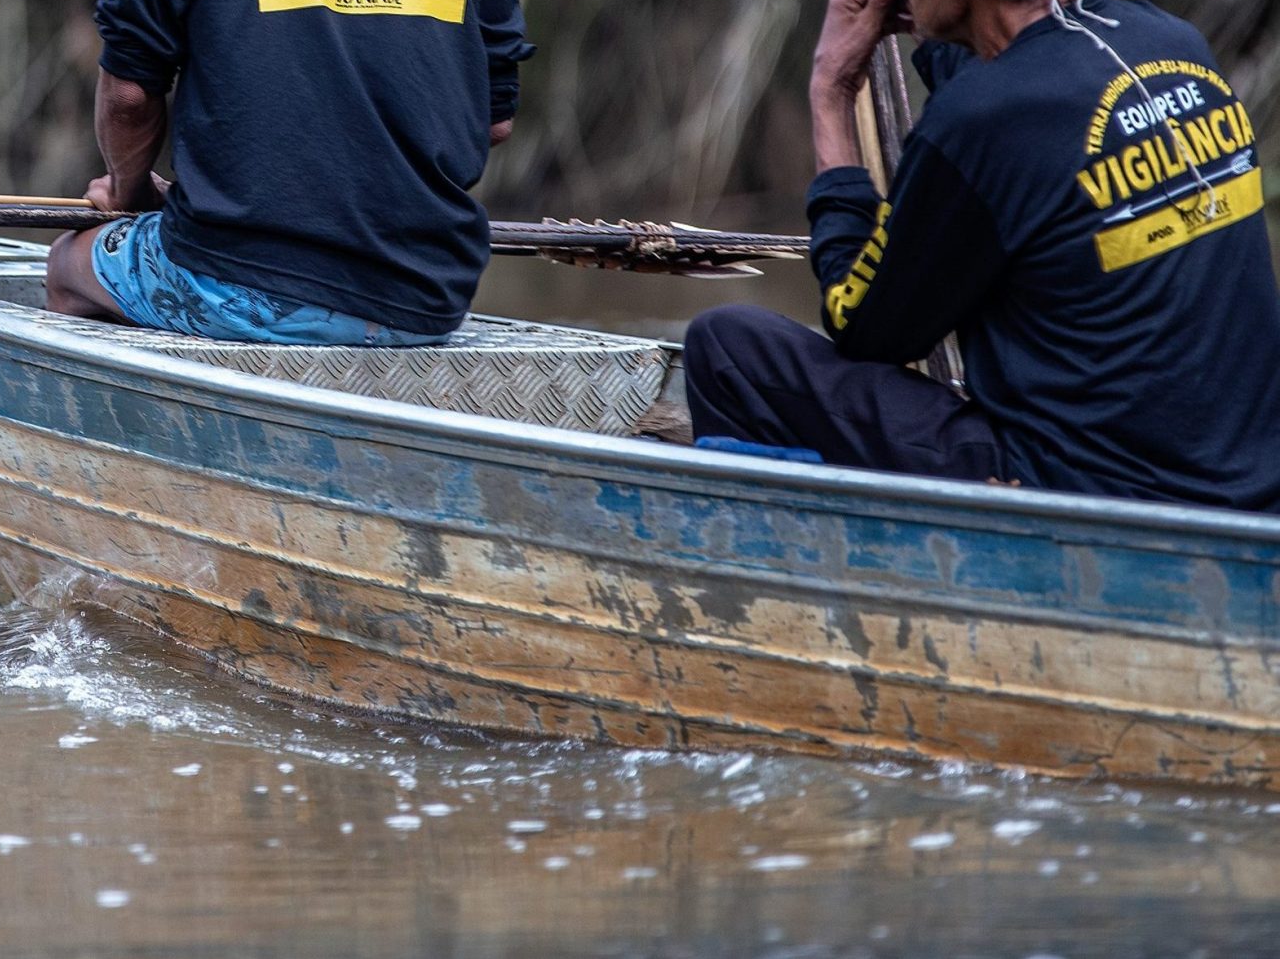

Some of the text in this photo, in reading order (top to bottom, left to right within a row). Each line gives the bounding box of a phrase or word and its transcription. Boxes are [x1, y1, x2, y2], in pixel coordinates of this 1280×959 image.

[1086, 107, 1110, 154] TERRA
[1100, 71, 1135, 109] INDÍGEN
[1117, 80, 1206, 134] EQUIPE DE
[1076, 101, 1256, 210] VIGILÂNCIA
